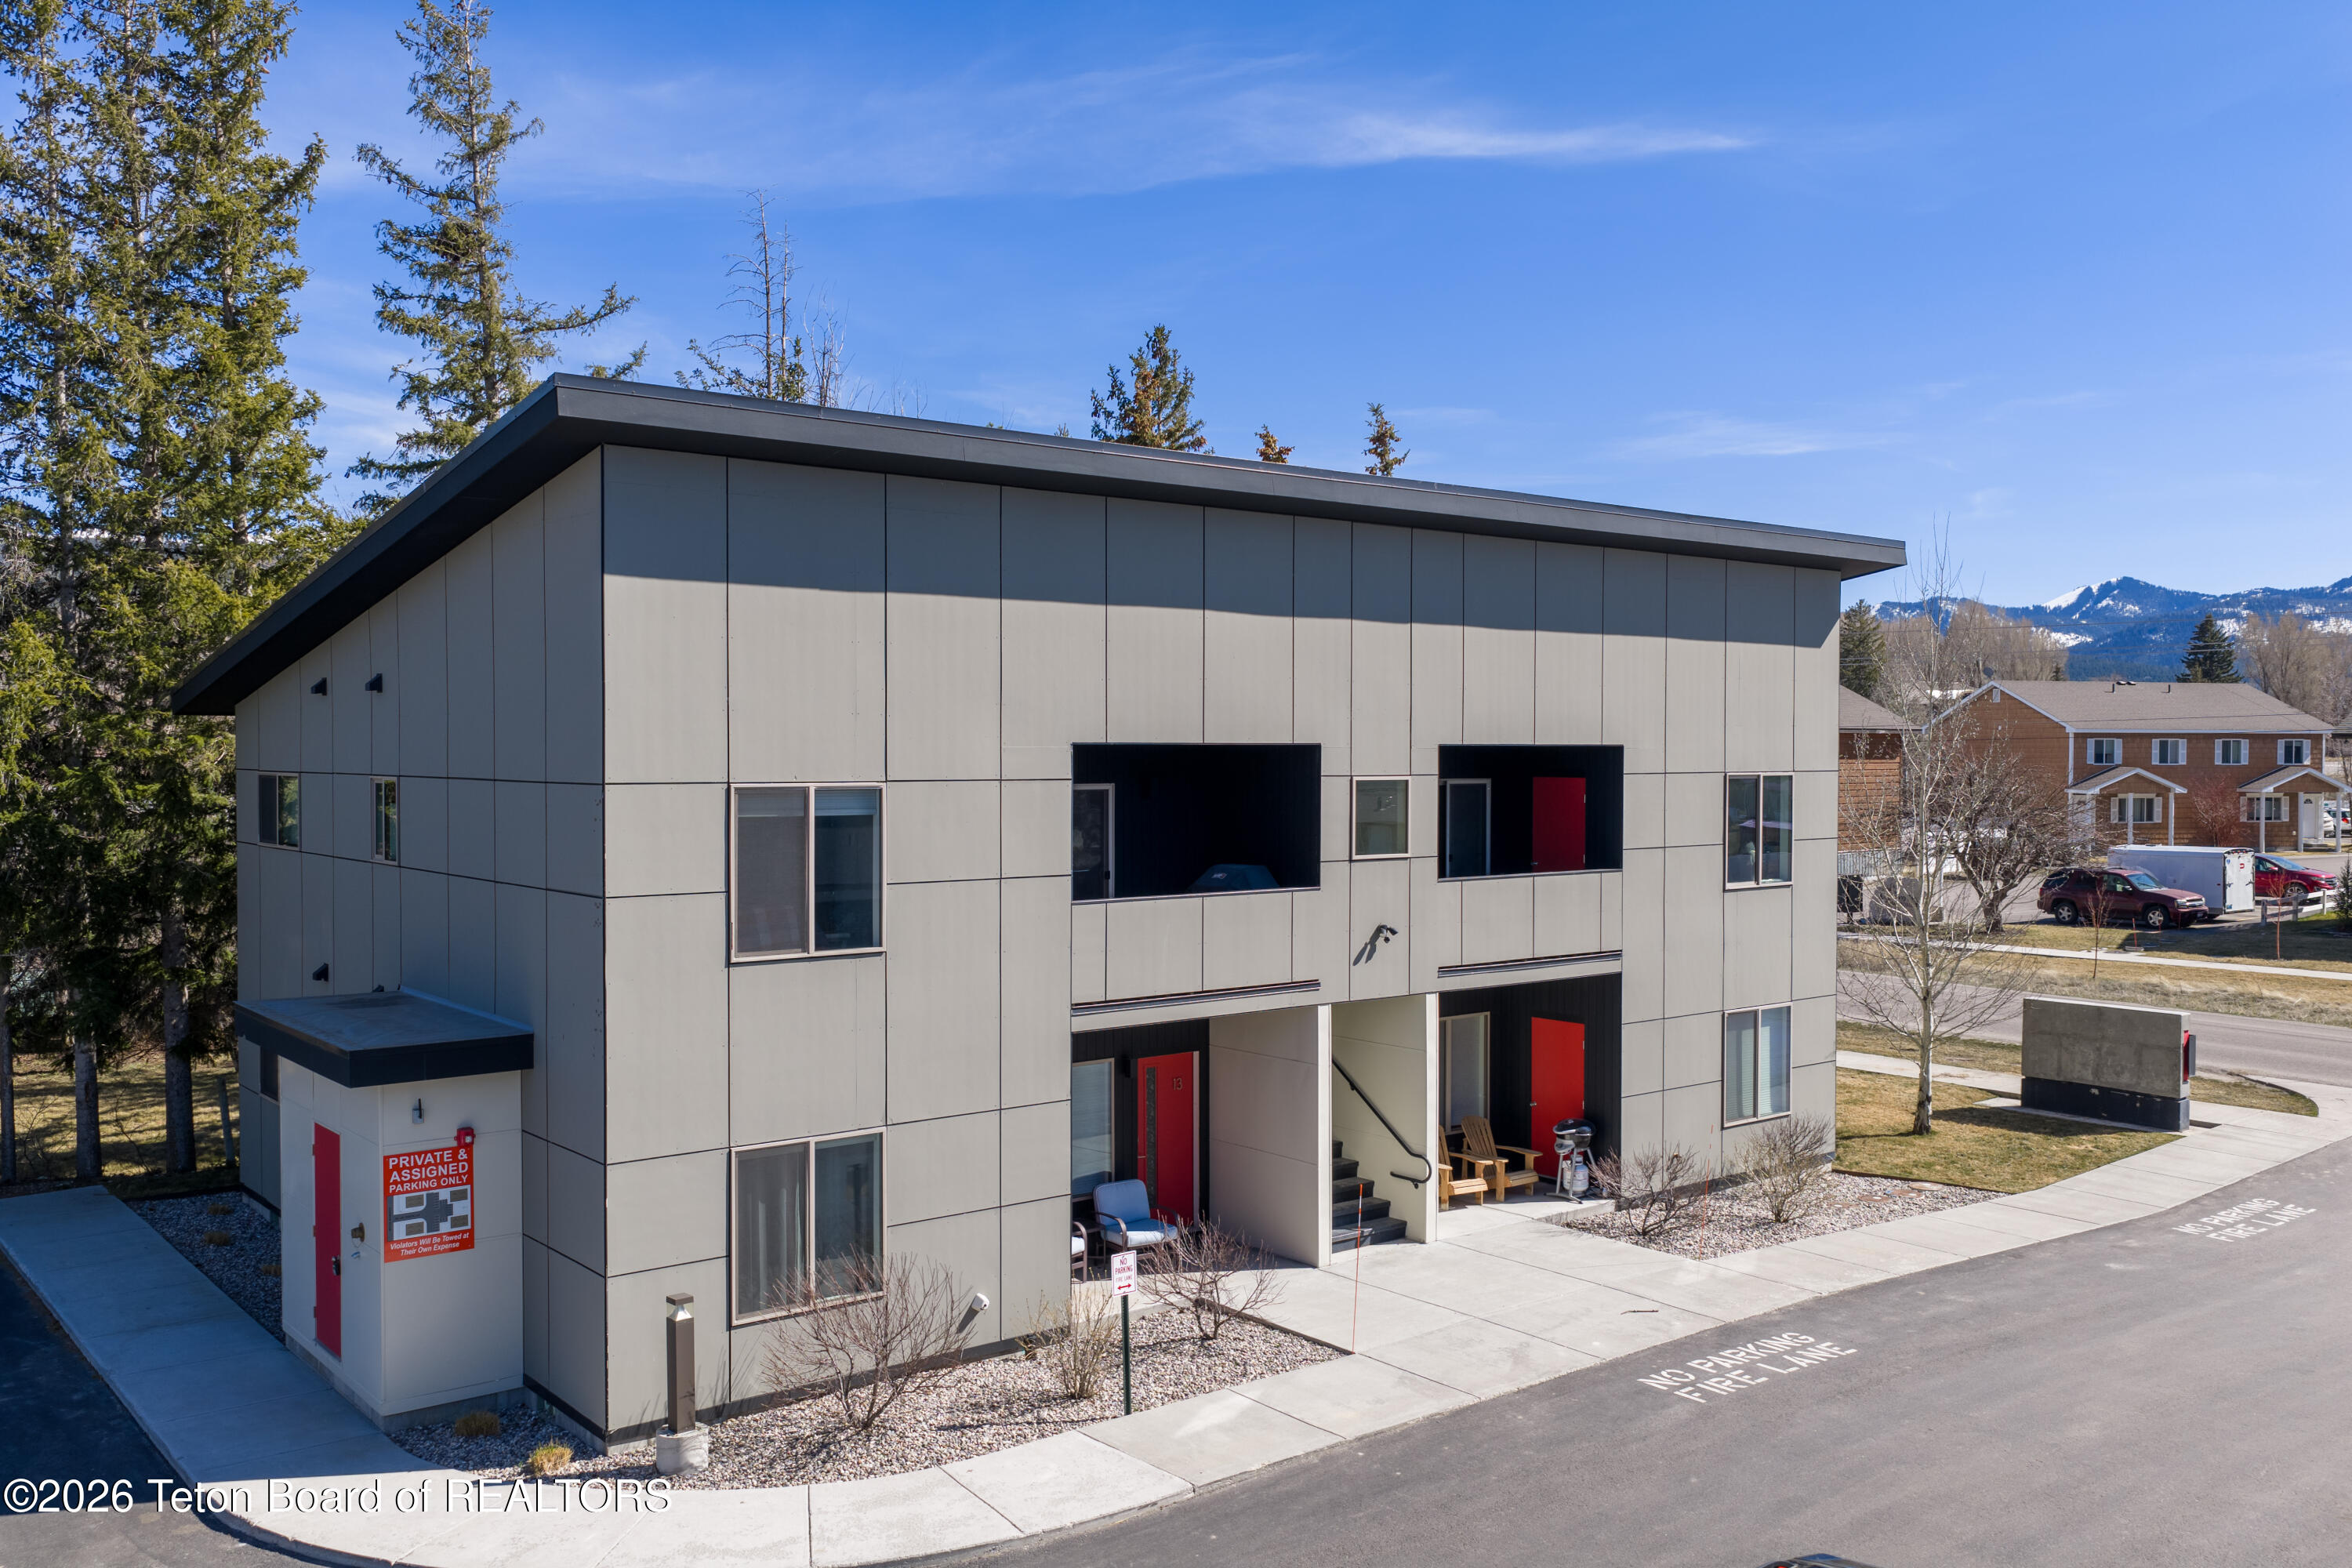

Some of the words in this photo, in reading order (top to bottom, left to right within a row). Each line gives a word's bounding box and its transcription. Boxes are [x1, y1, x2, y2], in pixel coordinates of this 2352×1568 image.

[1173, 1077, 1183, 1091] 13
[389, 1150, 452, 1169] PRIVATE
[458, 1149, 468, 1160] &
[390, 1162, 468, 1182] ASSIGNED
[390, 1179, 437, 1193] PARKING
[441, 1174, 468, 1186] ONLY
[2172, 1223, 2214, 1235] NO
[2198, 1198, 2280, 1226] PARKING
[2205, 1223, 2269, 1242] FIRE
[2251, 1203, 2318, 1227] LANE
[390, 1240, 418, 1250] Violators
[442, 1233, 462, 1242] Towed
[418, 1245, 432, 1254] Own
[433, 1242, 459, 1251] Expense
[1115, 1265, 1133, 1275] PARKING
[1120, 1258, 1127, 1266] NO
[1637, 1369, 1695, 1390] NO
[1686, 1332, 1815, 1373] PARKING
[1674, 1370, 1769, 1403] FIRE
[1756, 1342, 1858, 1374] LANE
